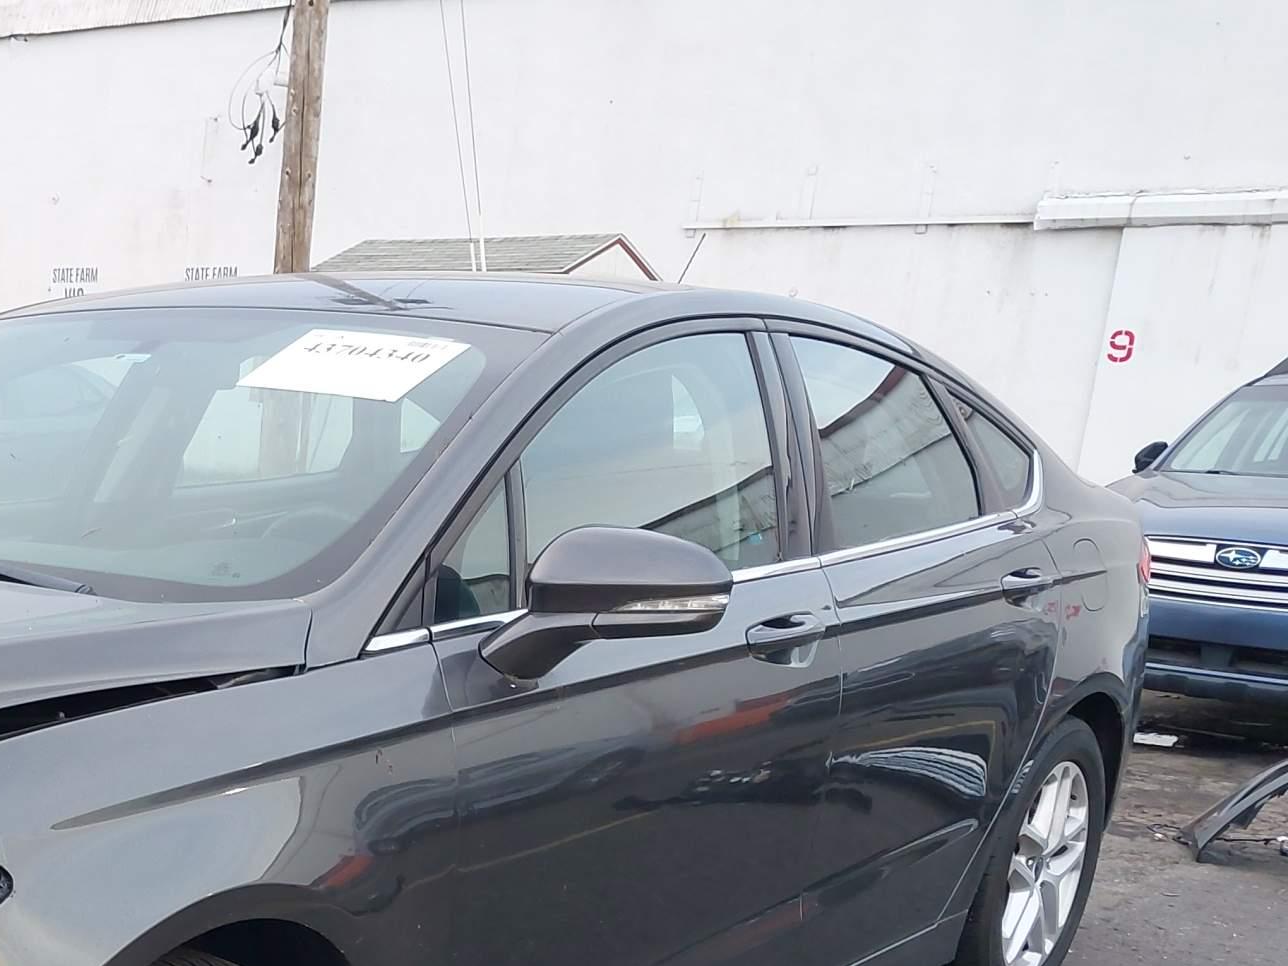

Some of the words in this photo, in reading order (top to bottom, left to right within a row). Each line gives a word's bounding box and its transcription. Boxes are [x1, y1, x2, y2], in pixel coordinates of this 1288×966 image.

[52, 267, 74, 284] STATE
[75, 267, 98, 283] FARM
[1107, 329, 1135, 363] 9
